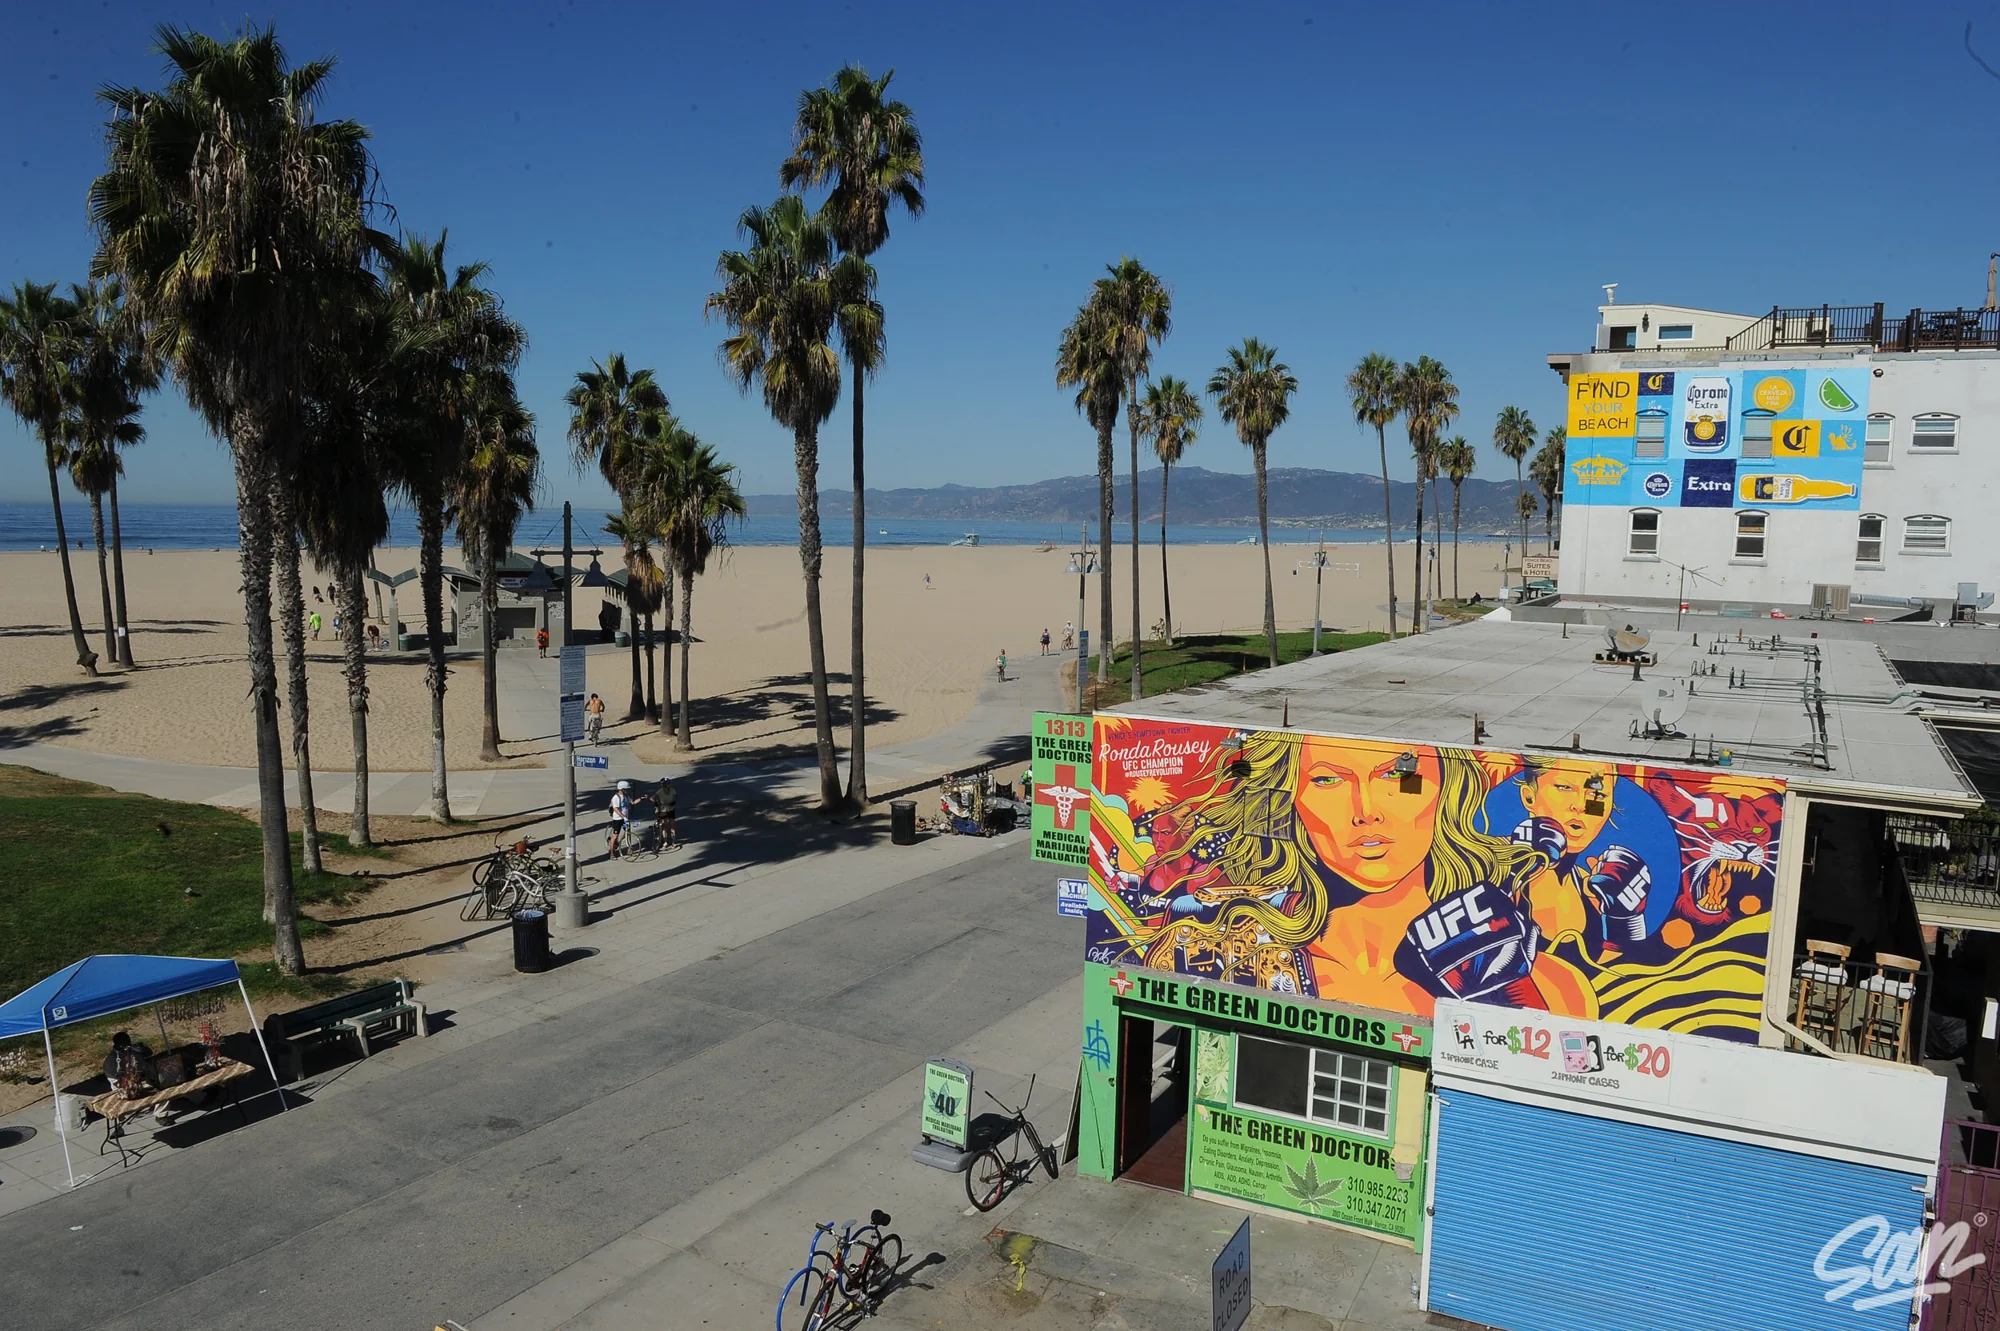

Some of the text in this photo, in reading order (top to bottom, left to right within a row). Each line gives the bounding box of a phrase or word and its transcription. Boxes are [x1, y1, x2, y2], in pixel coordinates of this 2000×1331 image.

[1687, 385, 1728, 402] Corona
[1583, 402, 1623, 415] YOUR
[1694, 400, 1719, 409] Extra
[1578, 417, 1629, 431] BEACH
[1687, 476, 1732, 491] Extra
[1045, 719, 1085, 738] 1313
[1035, 736, 1056, 749] THE
[1099, 738, 1212, 763] Ronda Rousey
[1038, 748, 1092, 764] DOCTORS
[1122, 756, 1184, 771] UFC CHAMPION
[1043, 830, 1086, 845] MEDICAL
[1414, 884, 1493, 951] UFC
[1137, 977, 1386, 1046] THE GREEN DOCTORS
[1506, 1025, 1552, 1060] $12
[1475, 1057, 1499, 1070] CASE
[1623, 1043, 1671, 1078] $20
[1551, 1071, 1558, 1080] 2
[1588, 1076, 1620, 1089] CASES
[935, 1093, 956, 1117] 40
[1210, 1110, 1242, 1136] THE
[1247, 1119, 1305, 1150] GREEN
[1346, 1195, 1407, 1223] 310.347.2071
[1219, 1251, 1244, 1298] ROAD
[1216, 1277, 1248, 1331] CLOSED
